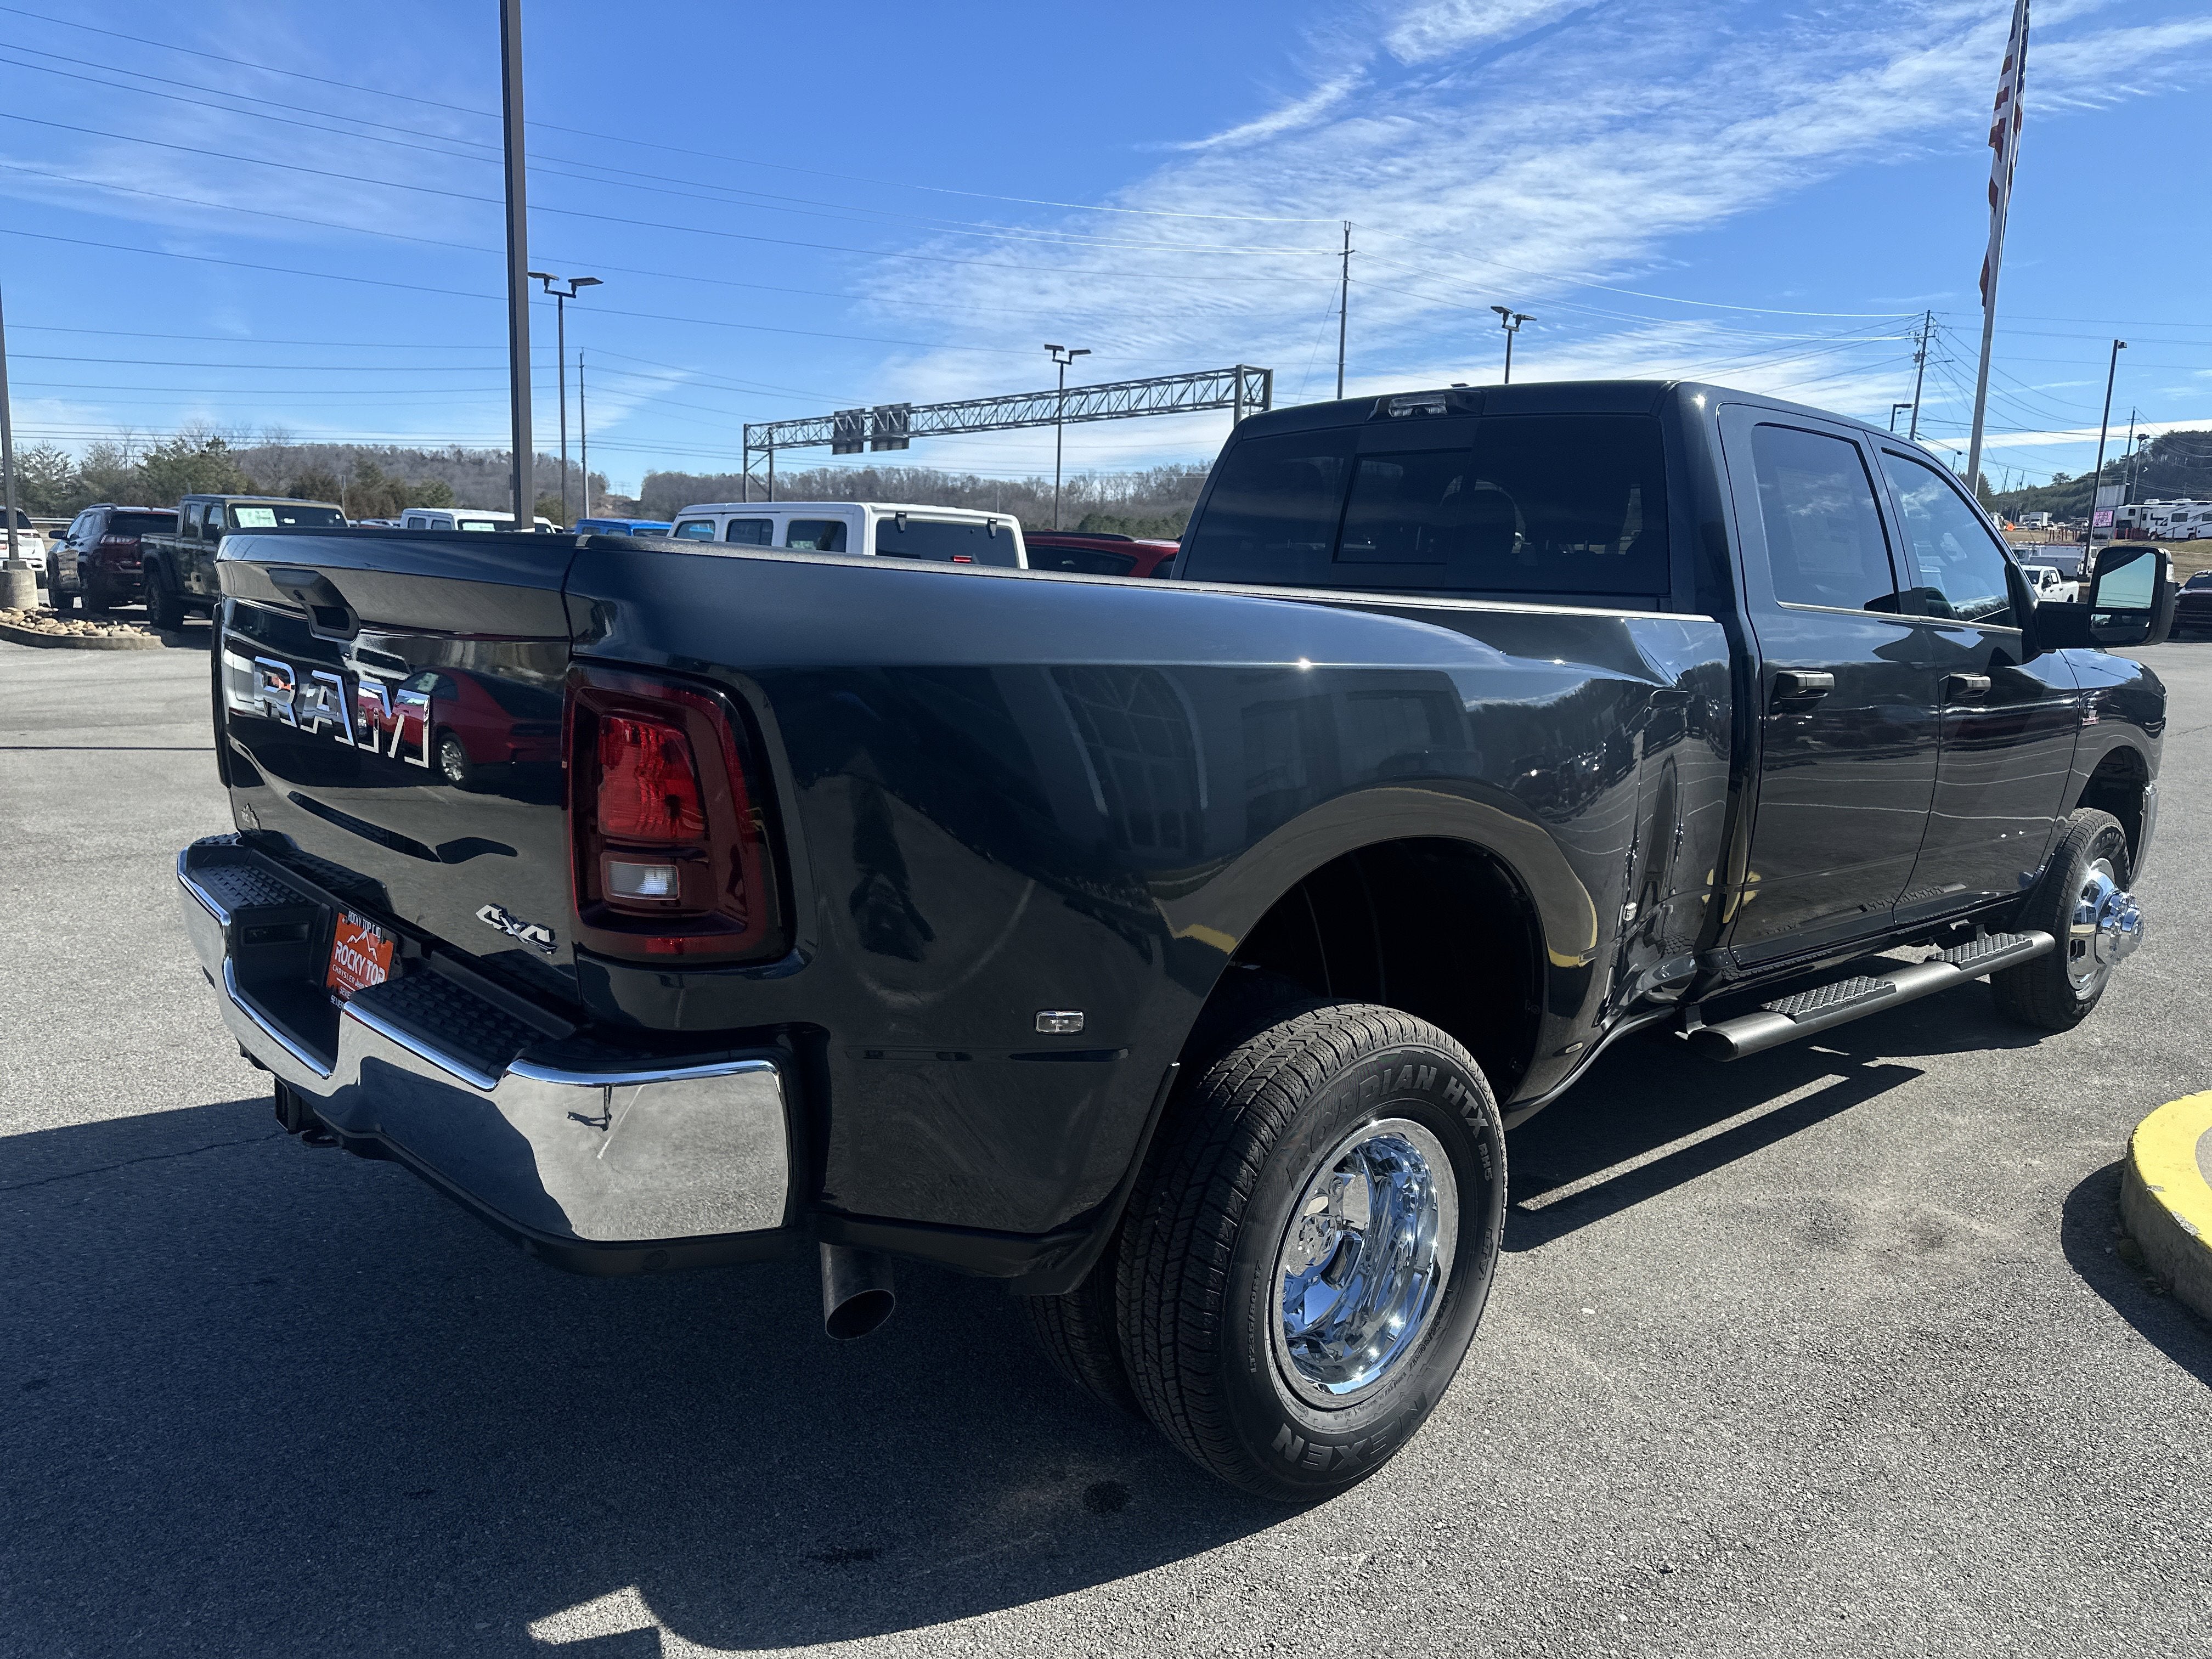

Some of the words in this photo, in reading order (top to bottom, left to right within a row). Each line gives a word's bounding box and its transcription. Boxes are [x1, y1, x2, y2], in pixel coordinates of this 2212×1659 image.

[255, 656, 430, 768] RAM
[348, 910, 362, 928] ROCKY
[363, 918, 372, 932] TOP
[332, 964, 356, 984] CHRYSLER
[334, 940, 366, 976] ROCKY
[366, 960, 386, 986] TOP
[1443, 1076, 1489, 1138] HTX
[1478, 1142, 1493, 1182] RH5
[1271, 1392, 1428, 1471] NEXEN
